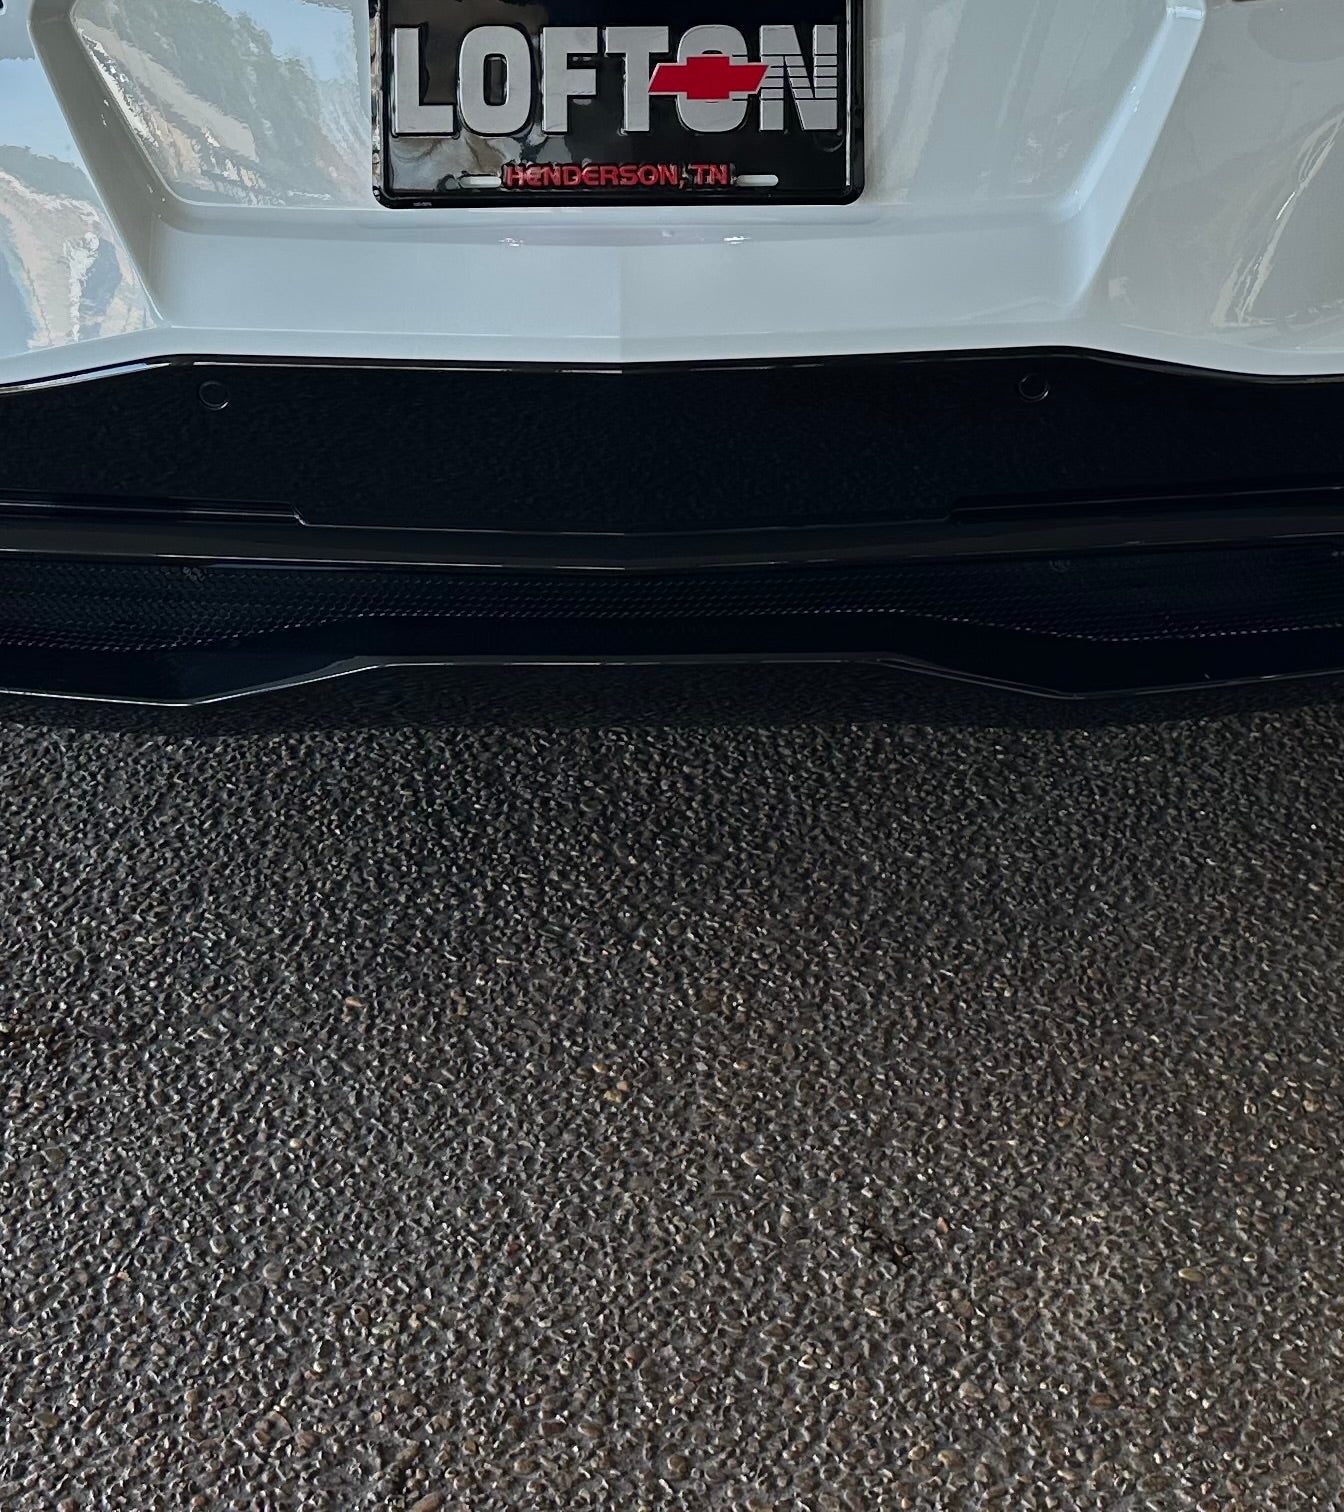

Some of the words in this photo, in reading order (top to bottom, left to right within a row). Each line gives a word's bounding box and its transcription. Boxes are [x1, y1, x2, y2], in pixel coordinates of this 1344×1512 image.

[392, 23, 839, 134] LOFTON
[506, 164, 685, 189] HENDERSON,
[691, 163, 730, 186] TN
